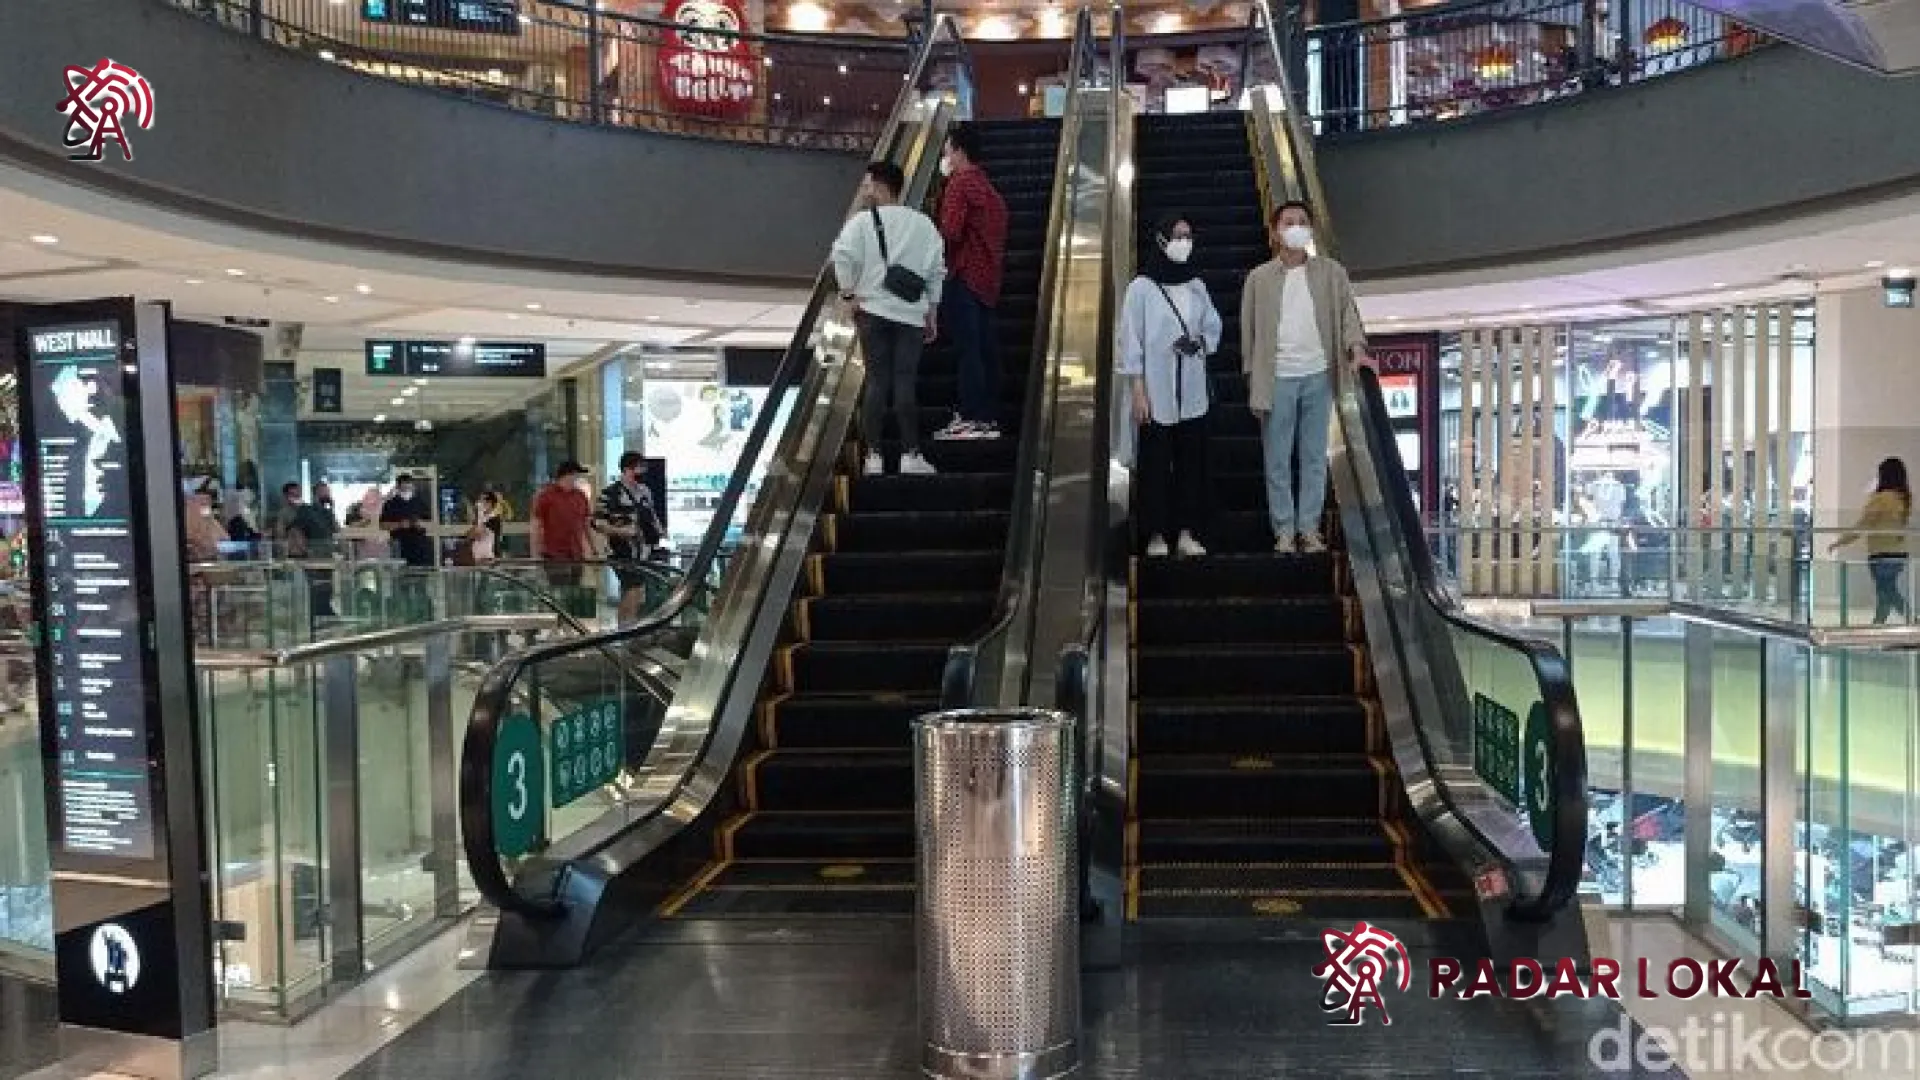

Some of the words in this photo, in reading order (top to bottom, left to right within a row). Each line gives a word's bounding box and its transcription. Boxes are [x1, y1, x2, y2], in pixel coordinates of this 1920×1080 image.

[33, 331, 75, 353] WEST
[507, 751, 528, 820] 3
[1534, 739, 1549, 812] 3
